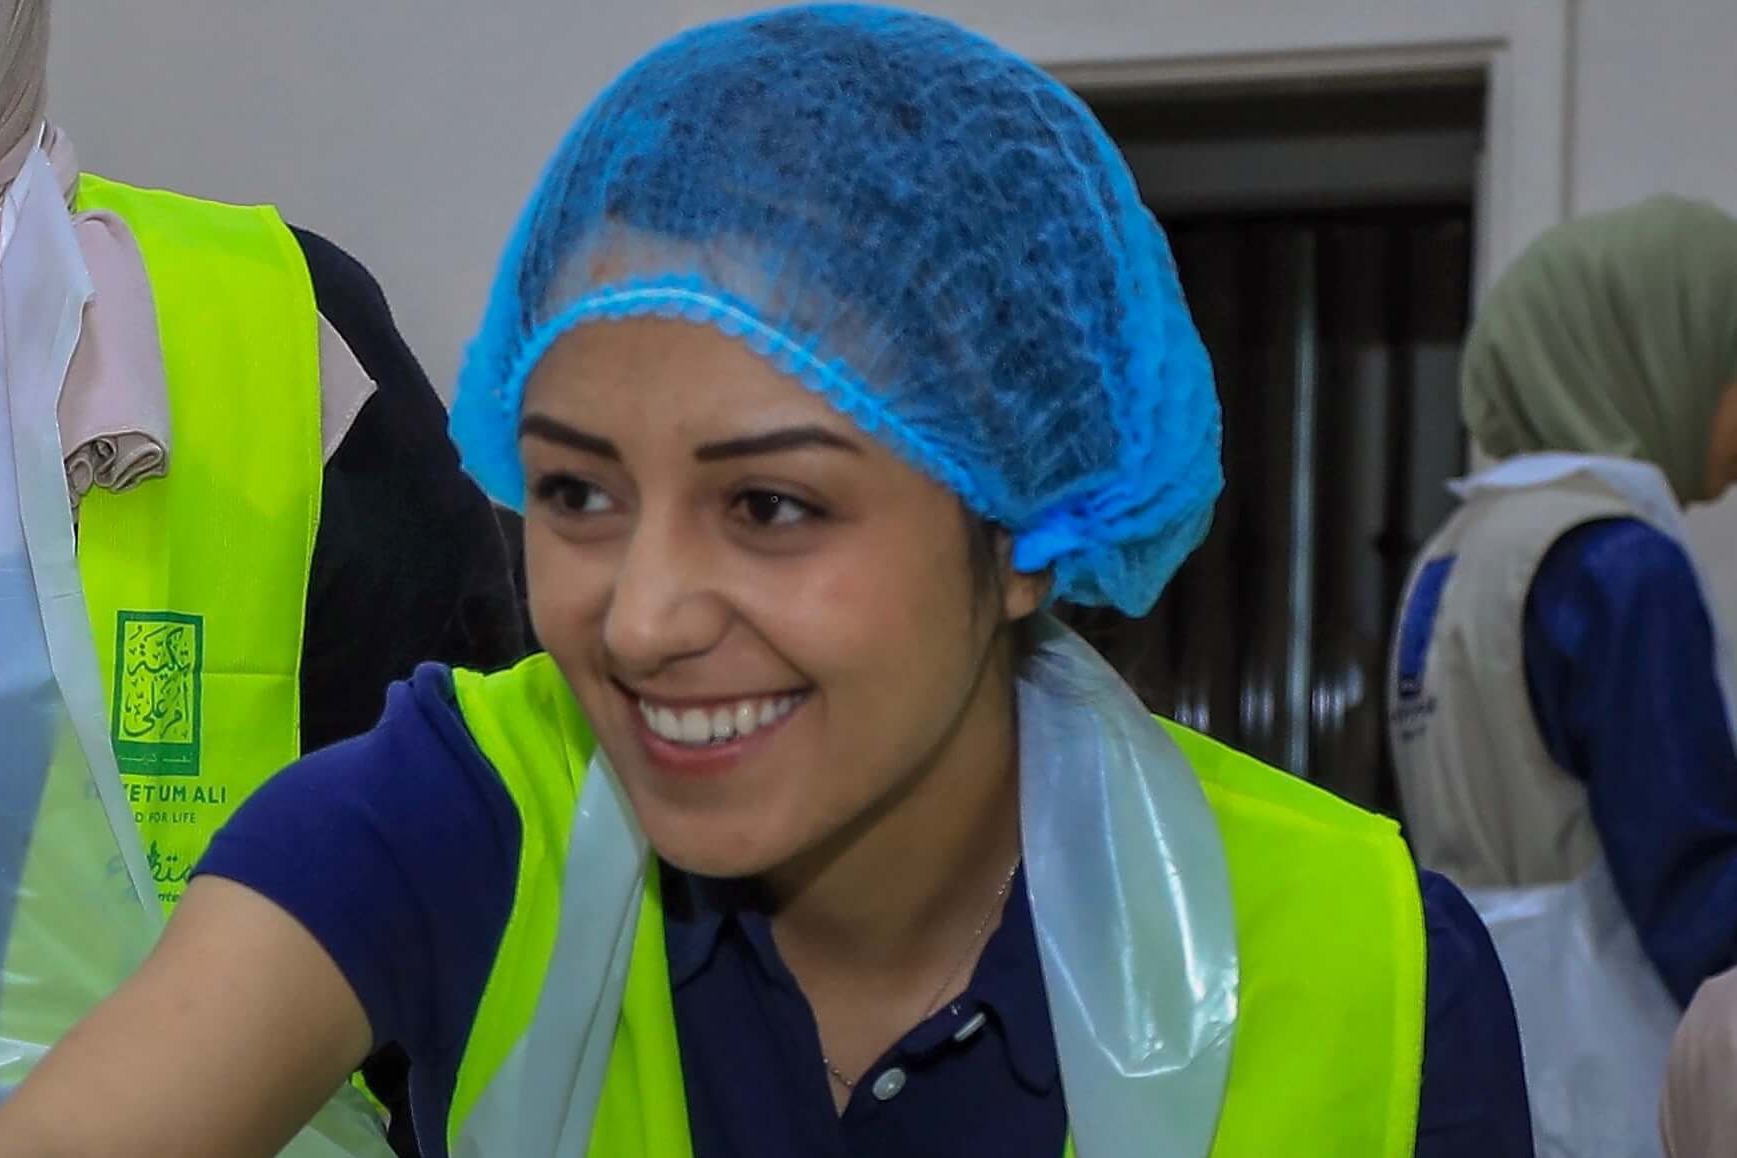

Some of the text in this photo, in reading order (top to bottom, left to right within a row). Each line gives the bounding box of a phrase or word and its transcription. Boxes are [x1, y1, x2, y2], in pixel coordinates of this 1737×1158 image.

[192, 786, 226, 804] ALI
[149, 811, 168, 823] FOR
[173, 812, 197, 824] LIFE
